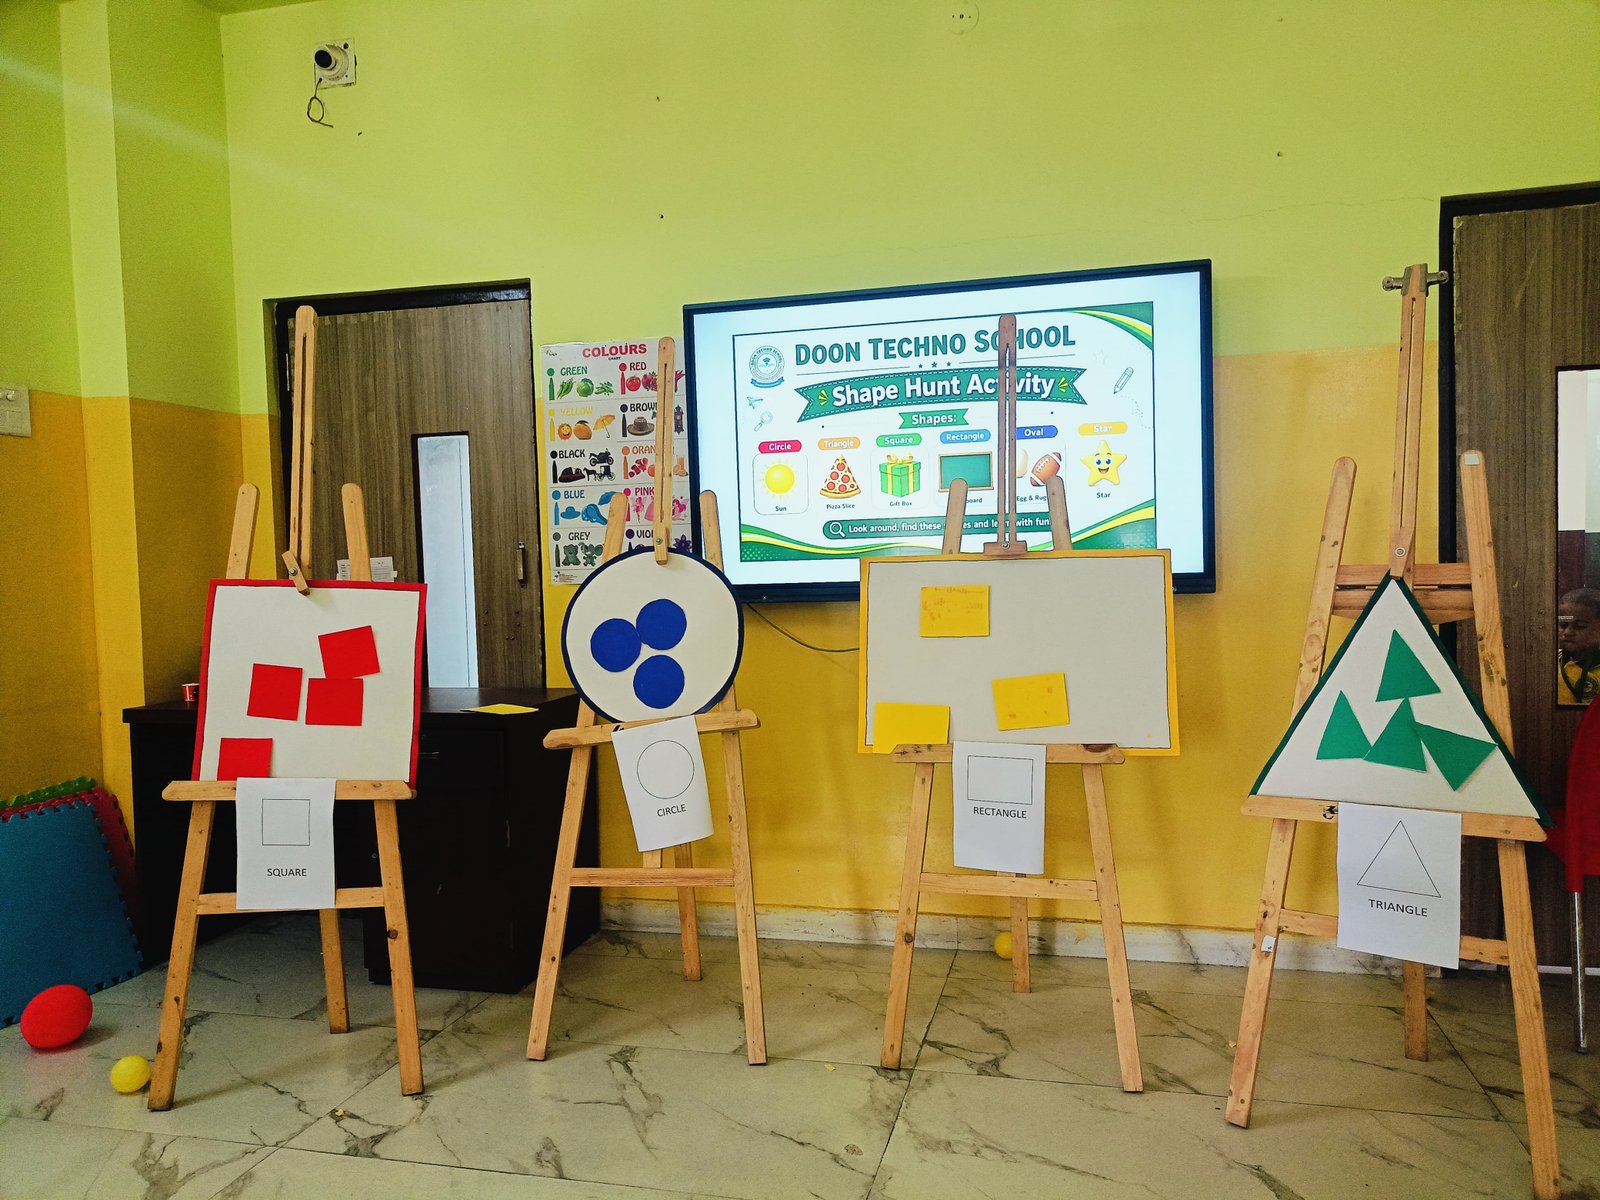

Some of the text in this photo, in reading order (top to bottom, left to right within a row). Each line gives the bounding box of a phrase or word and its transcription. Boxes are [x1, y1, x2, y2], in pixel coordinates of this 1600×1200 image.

[583, 344, 647, 358] COLOURS
[795, 341, 861, 366] DOON
[868, 333, 966, 361] TECHNO
[560, 366, 588, 376] GREEN
[629, 361, 647, 371] RED
[832, 371, 1056, 408] Shape Hunt Acivity
[560, 406, 593, 417] YELLOW
[911, 413, 957, 426] Shapes:
[1024, 428, 1044, 437] Oval
[1093, 424, 1113, 434] Star
[885, 436, 913, 446] Square
[946, 432, 985, 443] Rectangle
[768, 443, 792, 452] Circle
[824, 438, 855, 450] Triangle
[558, 449, 586, 459] BLACK
[563, 490, 585, 499] BLUE
[635, 487, 655, 496] PINK
[848, 524, 868, 533] Look
[901, 522, 918, 531] find
[919, 521, 942, 530] these
[973, 519, 989, 528] and
[1016, 517, 1033, 527] with
[568, 532, 591, 541] GREY
[657, 804, 686, 816] CIRCLE
[973, 806, 1027, 819] RECTANGLE
[267, 868, 306, 877] SQUARE
[1368, 898, 1428, 917] TRIANGLE
